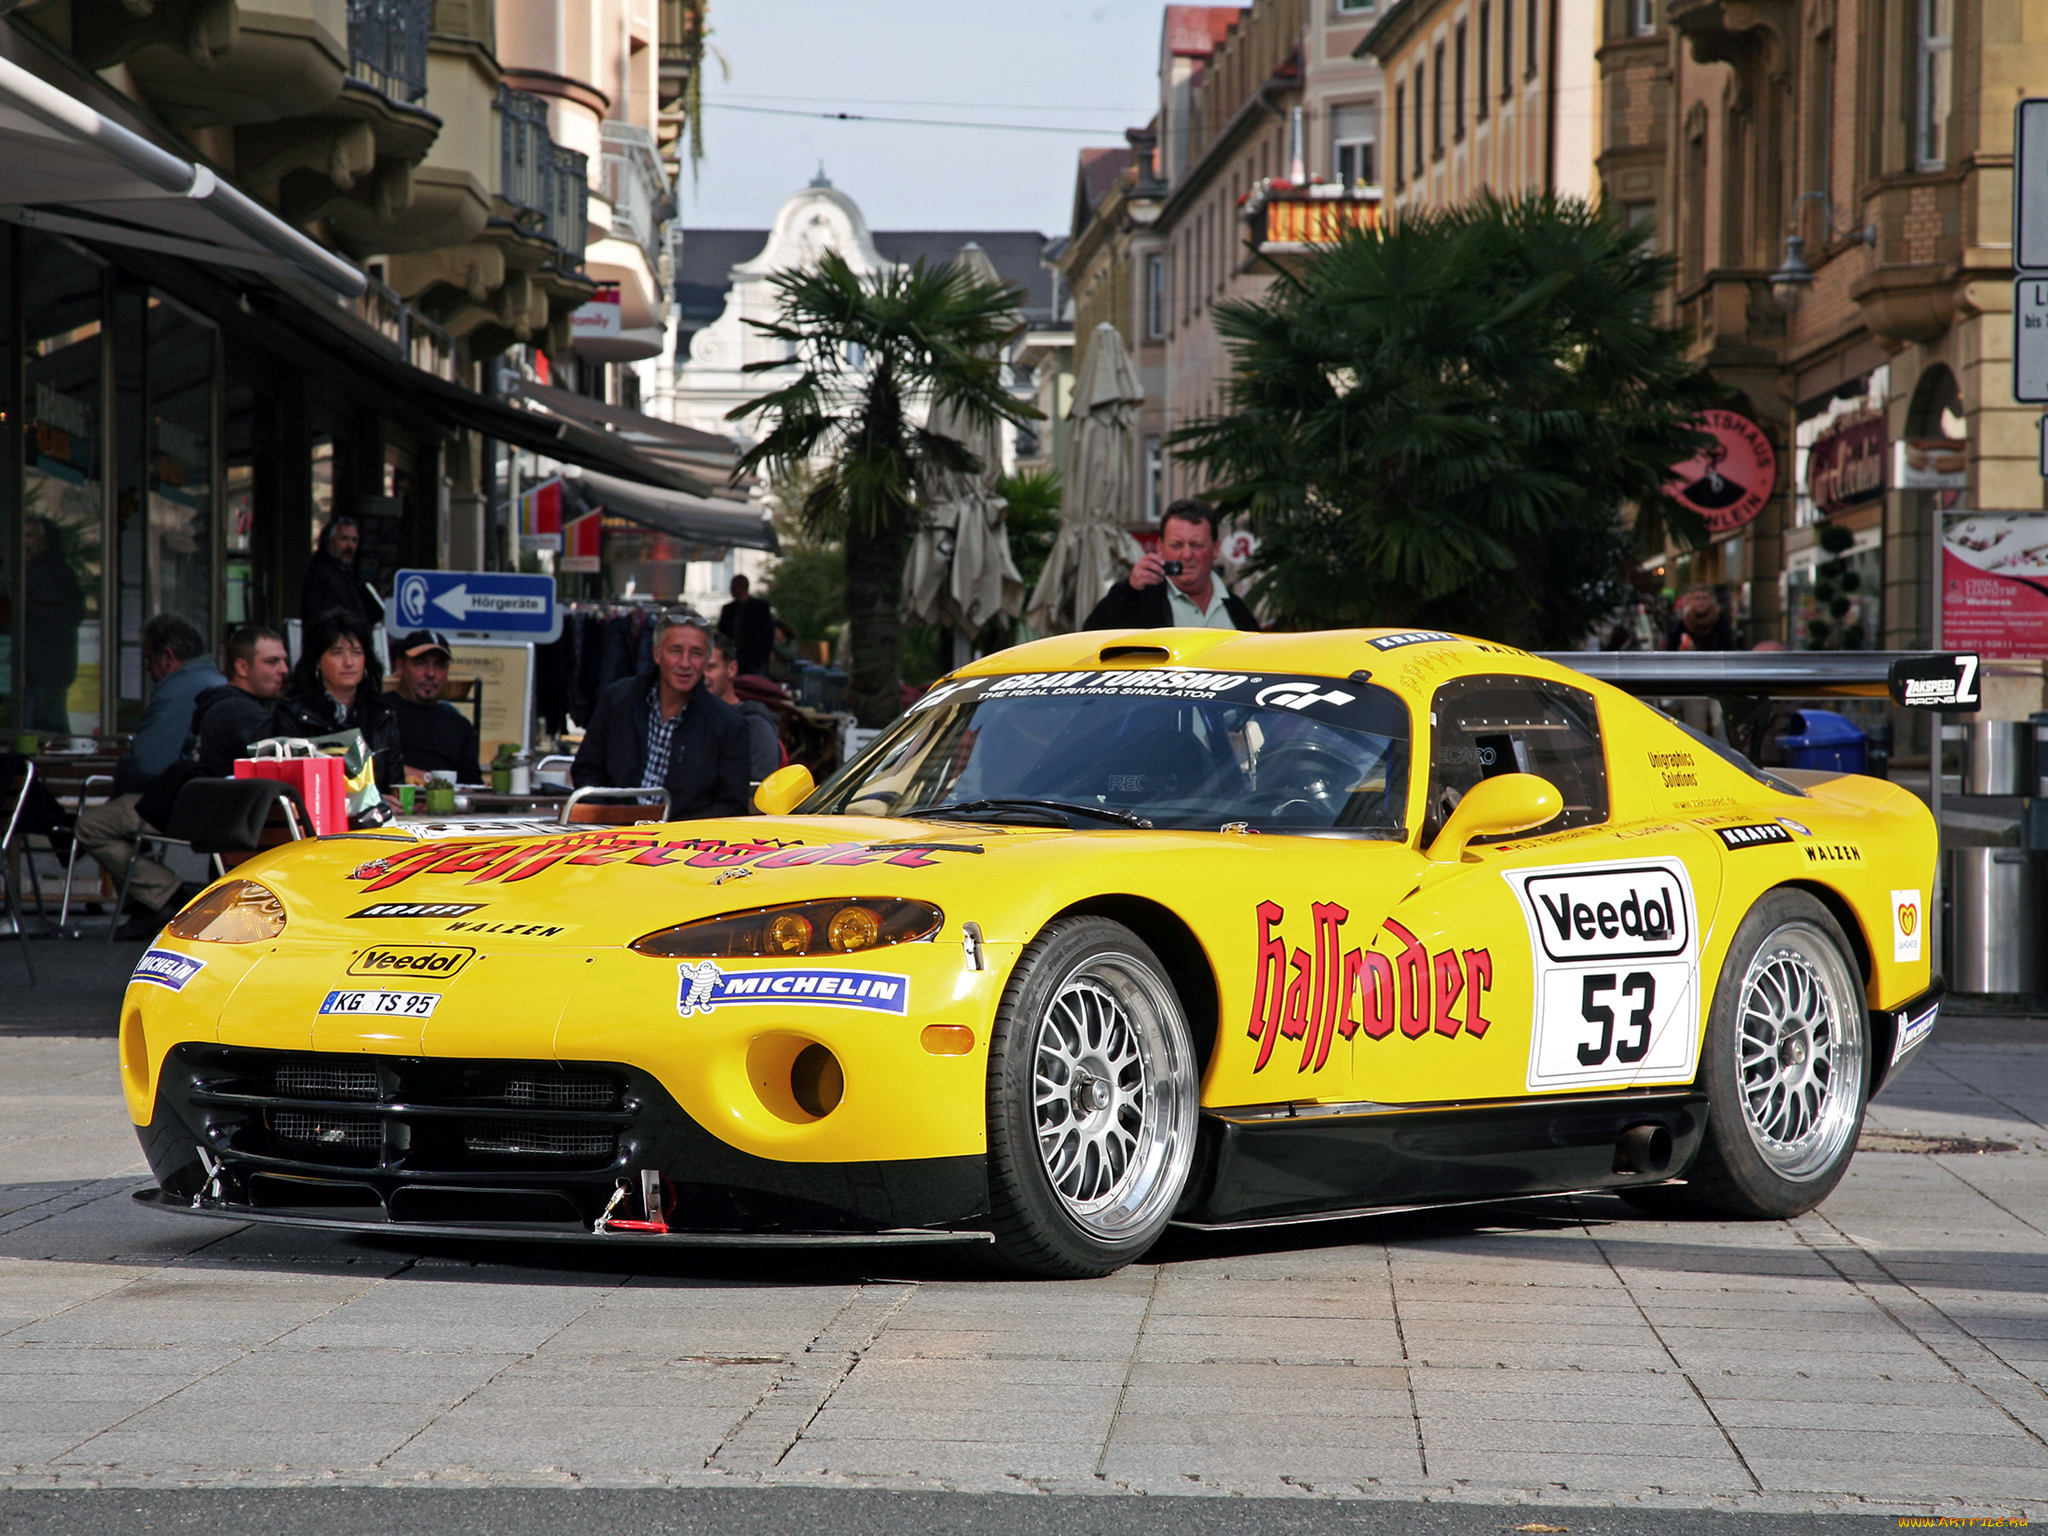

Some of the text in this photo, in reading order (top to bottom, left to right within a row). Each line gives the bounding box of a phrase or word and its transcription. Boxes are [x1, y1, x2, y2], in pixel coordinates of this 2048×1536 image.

[2025, 313, 2042, 329] bis
[1966, 579, 1999, 587] CHINA
[471, 596, 538, 610] Hörgeräte
[1966, 598, 2012, 606] Wellness
[1376, 633, 1452, 648] KRAFFT
[988, 671, 1248, 692] GRAN TURISMO
[1905, 679, 1956, 697] ZAKSPEED
[1955, 656, 1978, 703] Z
[978, 687, 1217, 700] THE REAL DRIVING SIMULATOR
[1905, 696, 1956, 706] RACING
[1646, 751, 1695, 768] Unigraphics
[1108, 774, 1180, 792] RECARO
[1663, 772, 1698, 789] Solutions
[1632, 822, 1680, 838] Ludwig
[1723, 825, 1786, 844] KRAFFT
[1803, 844, 1861, 862] WALZEN
[360, 905, 476, 917] KRAFFT
[1539, 886, 1674, 942] Veedol
[443, 920, 565, 938] WALZEN
[360, 951, 462, 972] Veedol
[1047, 952, 1064, 971] Pilot
[1063, 937, 1083, 954] Sport
[141, 954, 199, 981] MICHELIN
[724, 976, 898, 1000] MICHELIN
[334, 993, 434, 1014] KG TS 95
[1576, 971, 1656, 1067] 53
